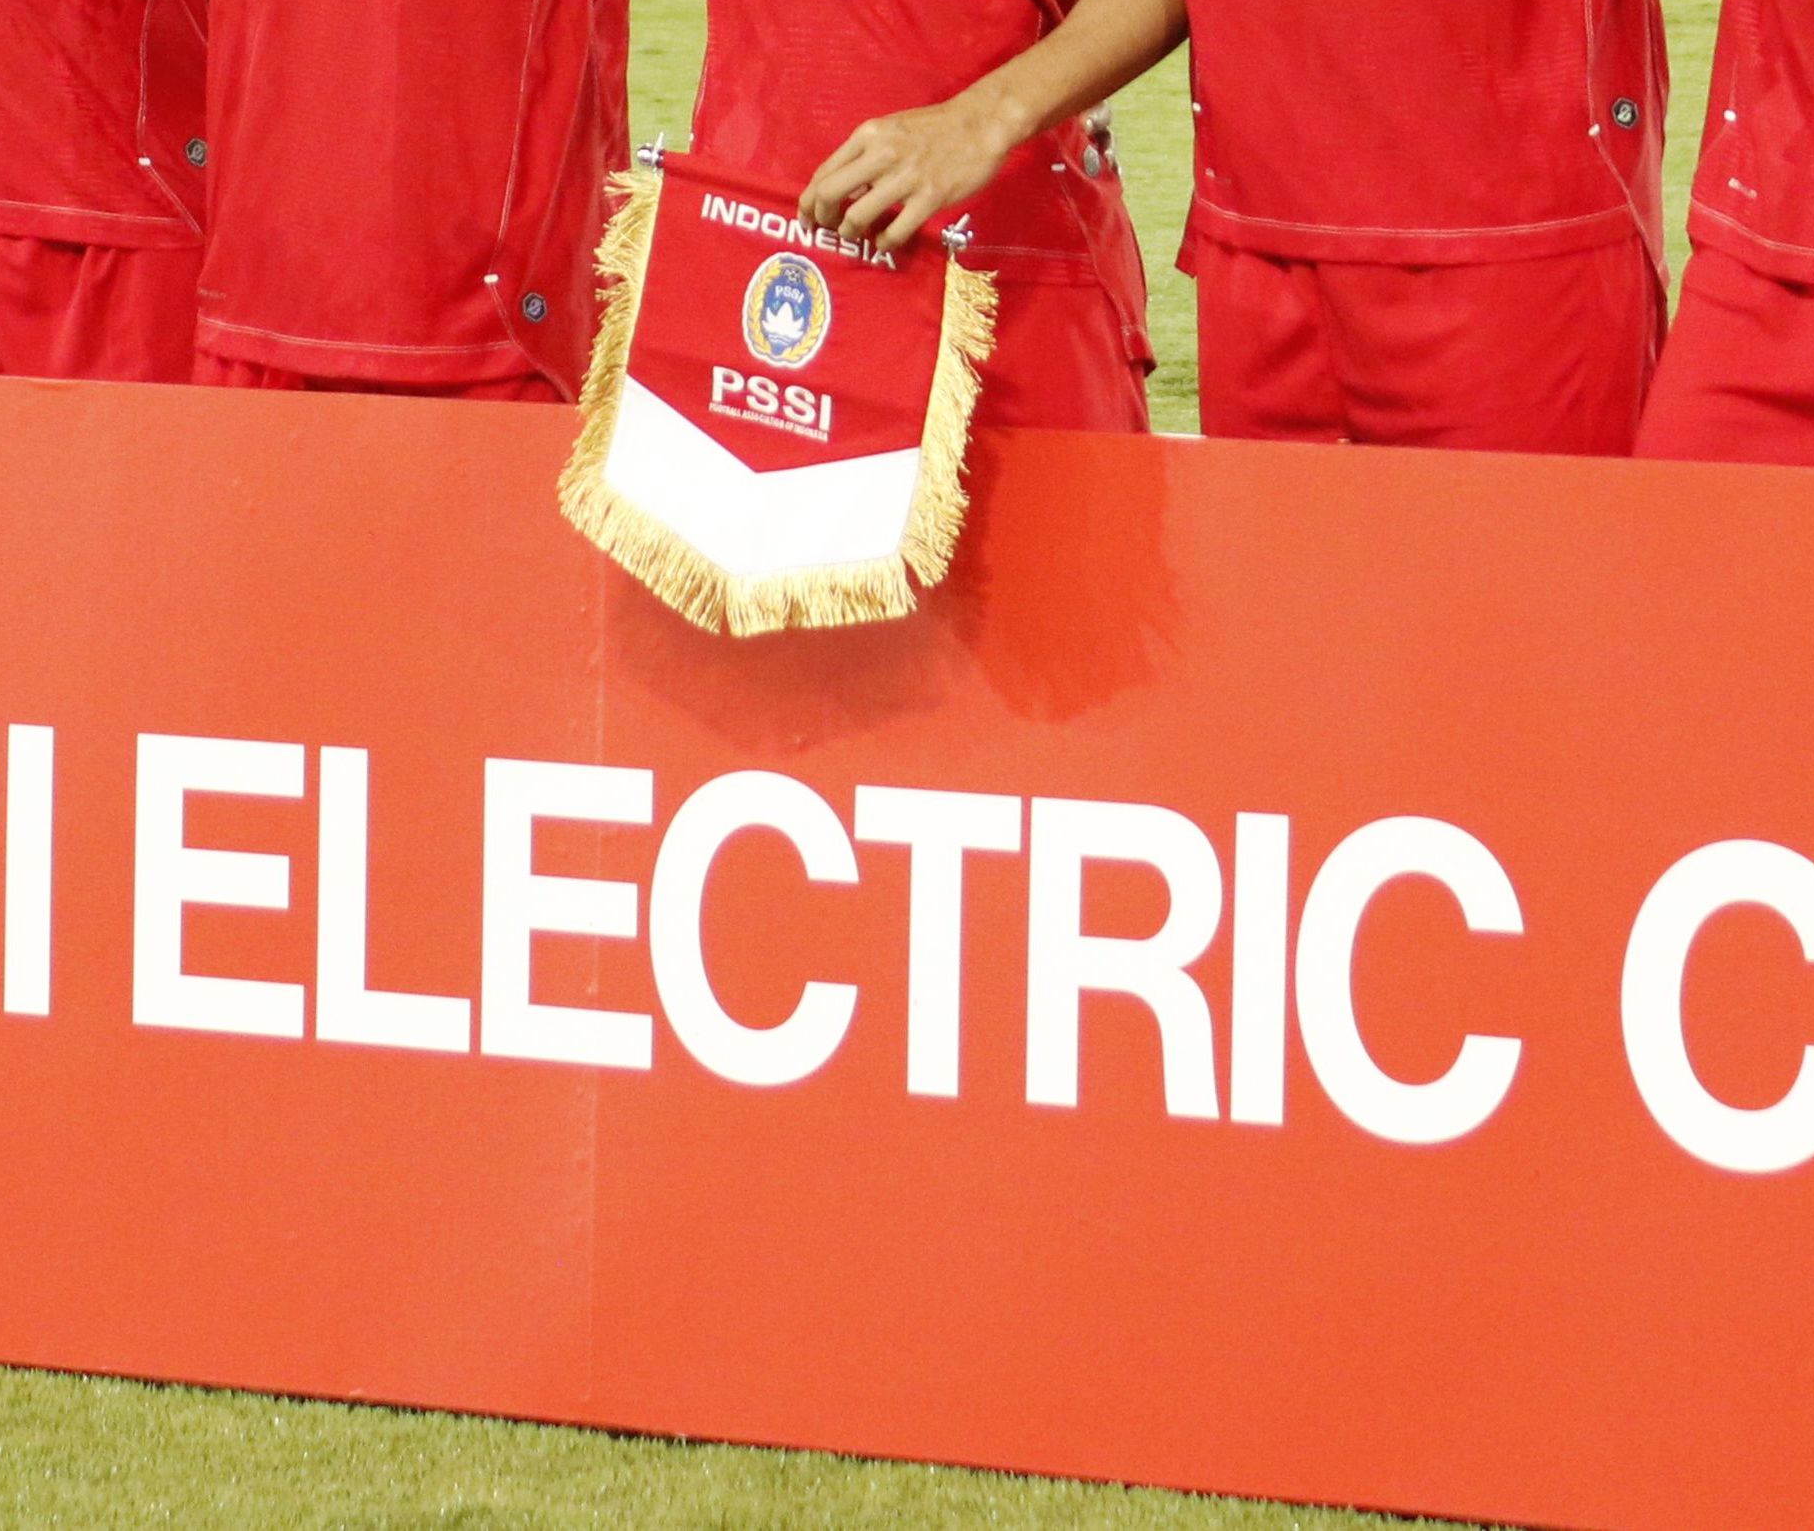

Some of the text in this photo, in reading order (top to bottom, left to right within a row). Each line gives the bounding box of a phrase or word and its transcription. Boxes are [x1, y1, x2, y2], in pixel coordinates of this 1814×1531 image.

[700, 193, 897, 270] INDONESIA
[775, 285, 804, 302] PSSI
[712, 365, 832, 432] PSSI
[132, 732, 1525, 1146] ELECTRIC
